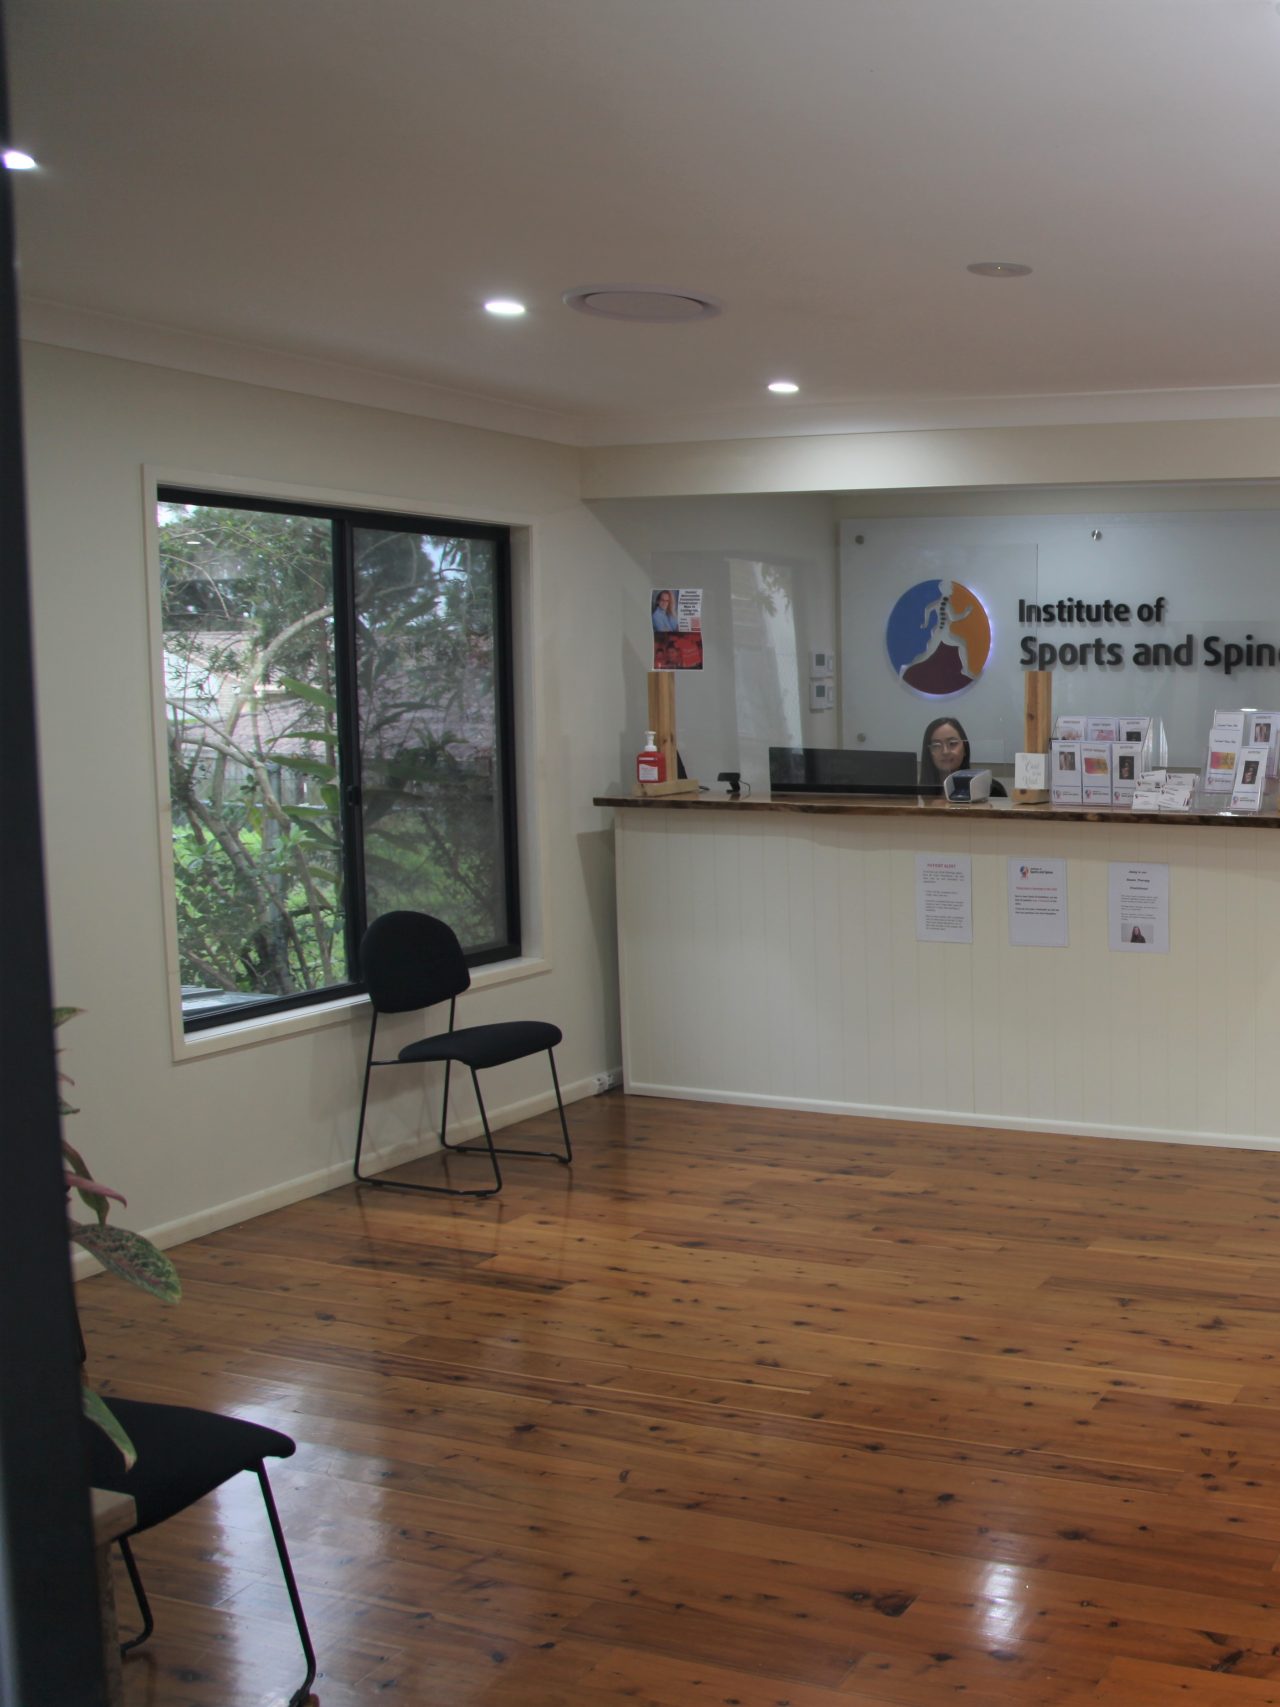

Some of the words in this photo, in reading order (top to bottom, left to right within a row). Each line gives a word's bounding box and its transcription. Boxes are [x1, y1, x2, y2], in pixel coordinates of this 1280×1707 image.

[1018, 597, 1130, 624] Institute
[1136, 596, 1166, 624] of
[1019, 635, 1123, 671] Sports
[1132, 633, 1194, 667] and
